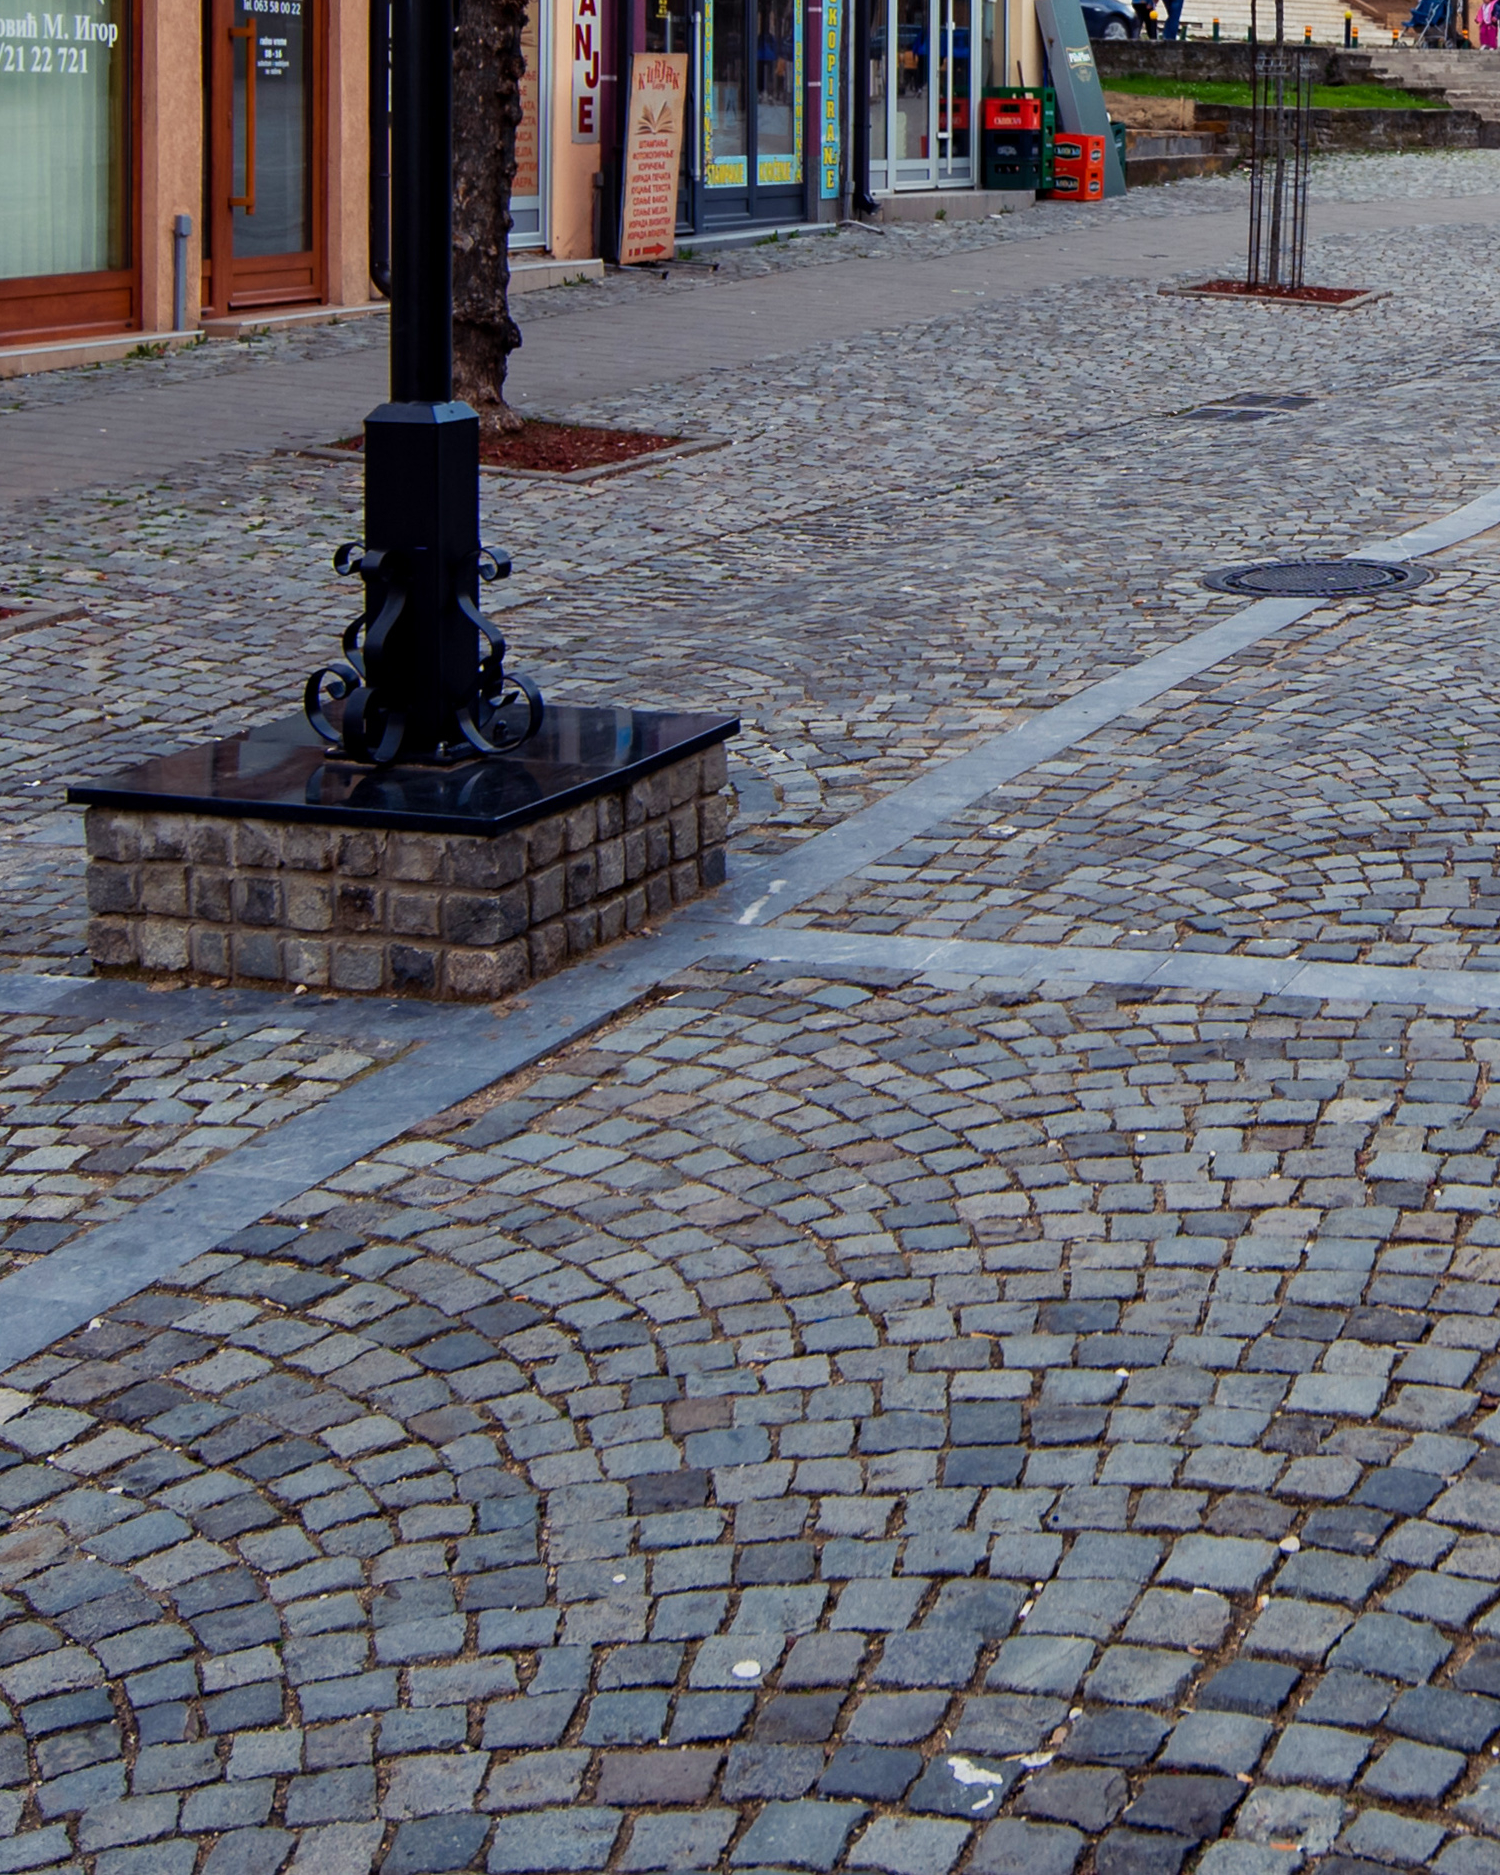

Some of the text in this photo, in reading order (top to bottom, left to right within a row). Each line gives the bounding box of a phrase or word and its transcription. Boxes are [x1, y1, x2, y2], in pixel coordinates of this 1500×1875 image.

[254, 0, 269, 12] 063
[269, 0, 280, 14] 58
[280, 1, 291, 15] 00
[291, 2, 301, 15] 22
[43, 13, 70, 40] М.
[74, 14, 119, 48] Игор
[30, 45, 52, 73] 22
[57, 46, 89, 74] 721
